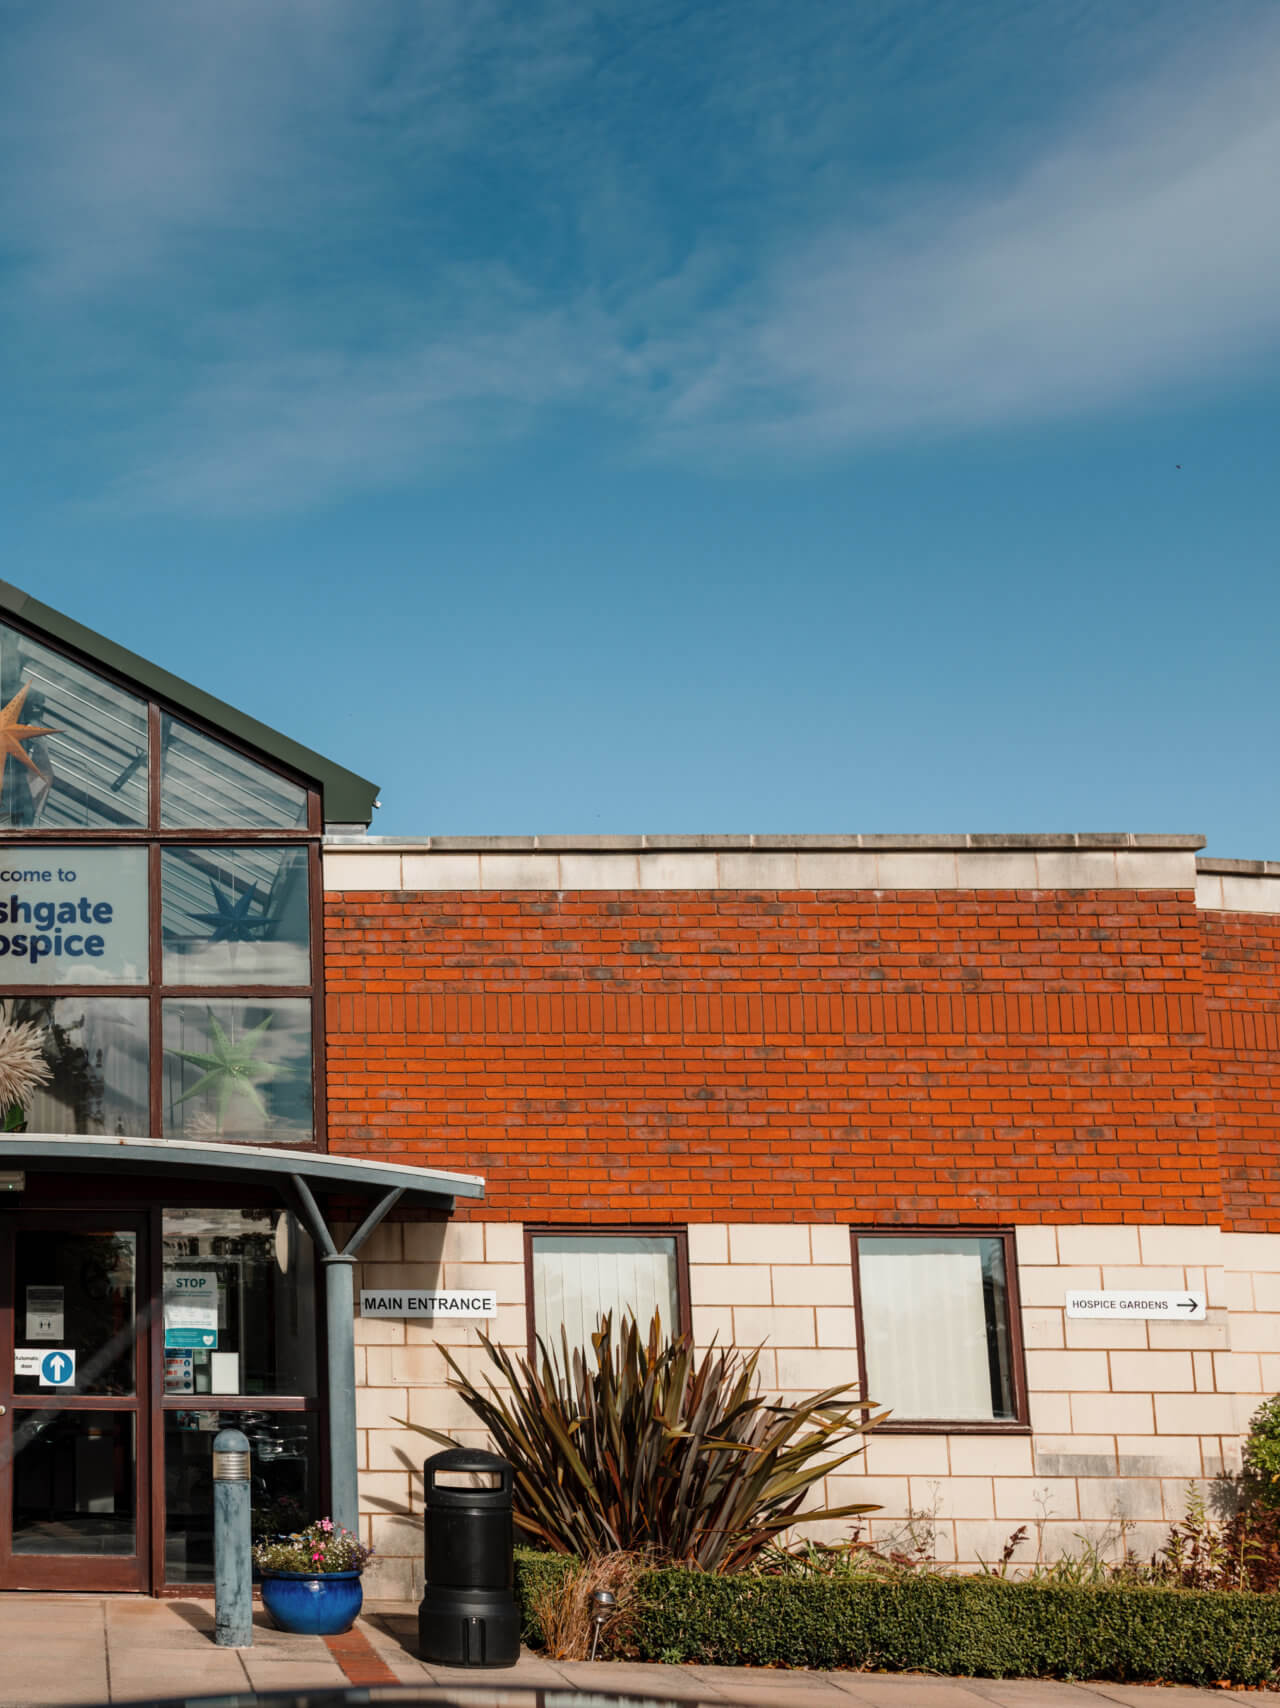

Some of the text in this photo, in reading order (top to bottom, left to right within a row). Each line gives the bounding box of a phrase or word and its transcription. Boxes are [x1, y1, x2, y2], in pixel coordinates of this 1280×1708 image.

[57, 868, 77, 882] to
[175, 1277, 207, 1288] STOP
[364, 1297, 492, 1311] MAIN ENTRANCE
[1072, 1299, 1169, 1310] HOSPICE GARDENS
